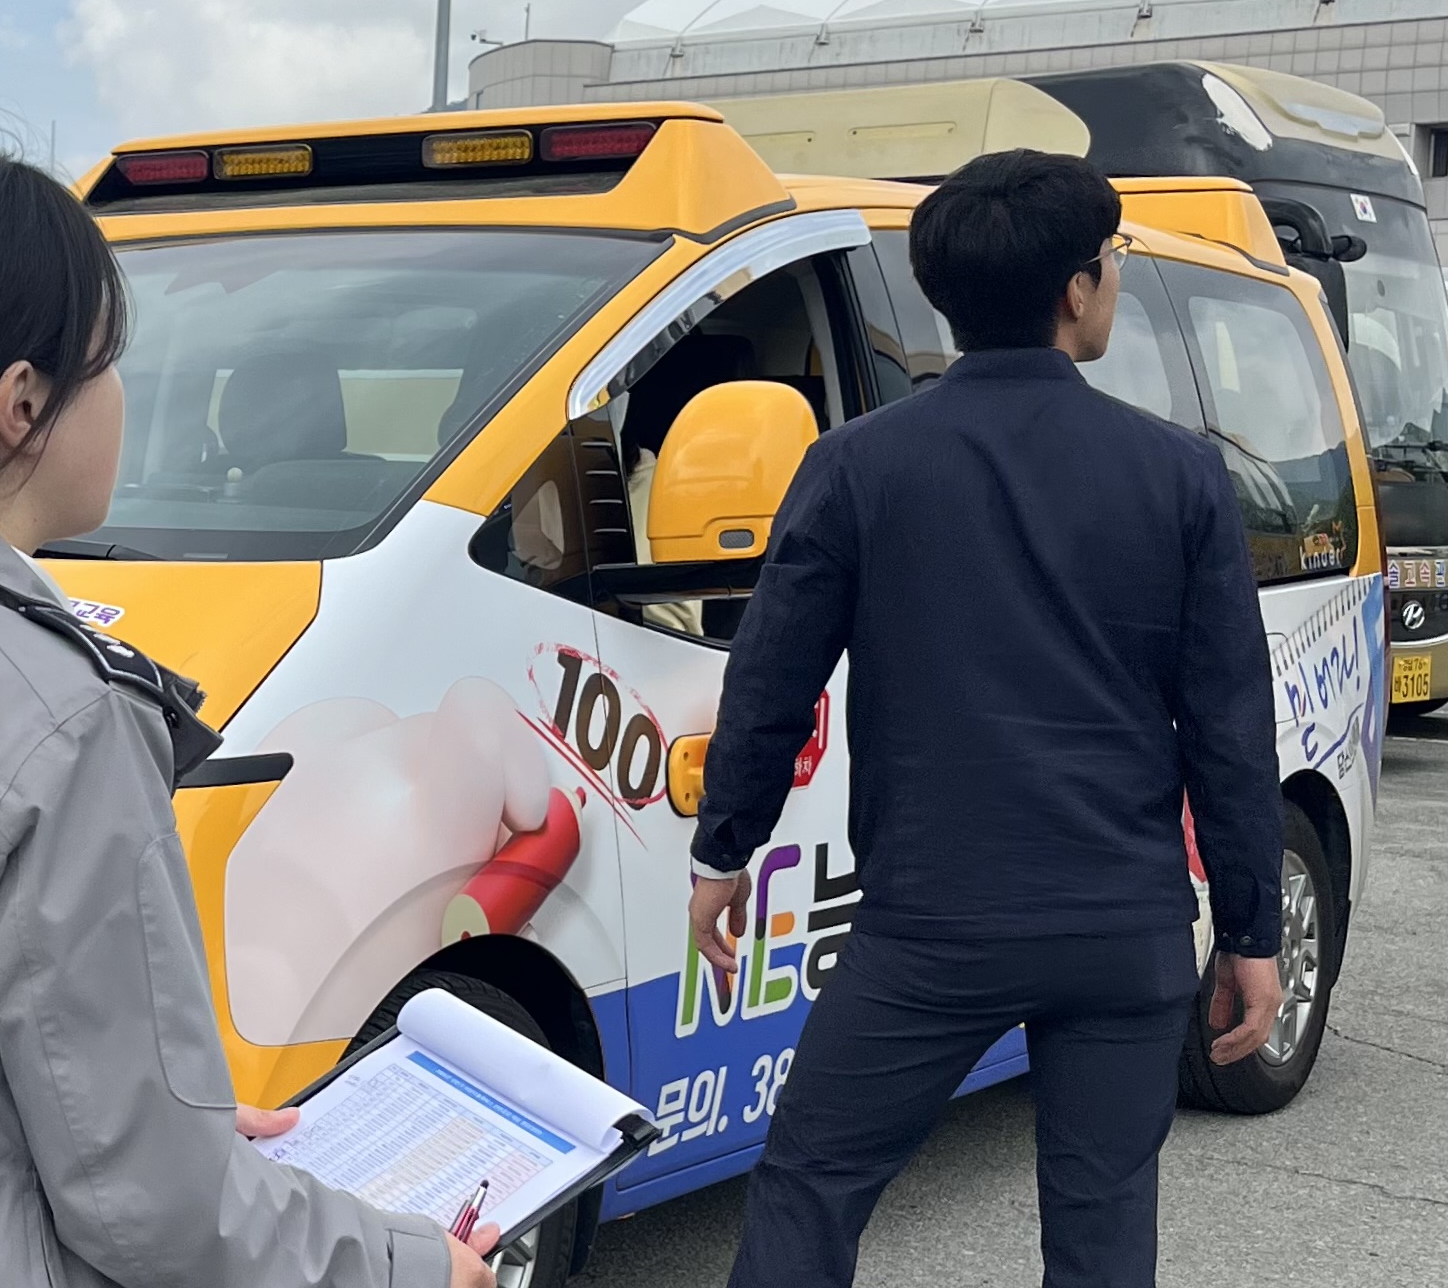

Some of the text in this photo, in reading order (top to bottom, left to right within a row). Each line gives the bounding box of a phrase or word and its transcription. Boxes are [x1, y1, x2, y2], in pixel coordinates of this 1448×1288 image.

[1299, 545, 1342, 571] kinder
[553, 648, 661, 810] 100
[743, 1048, 795, 1124] 38
